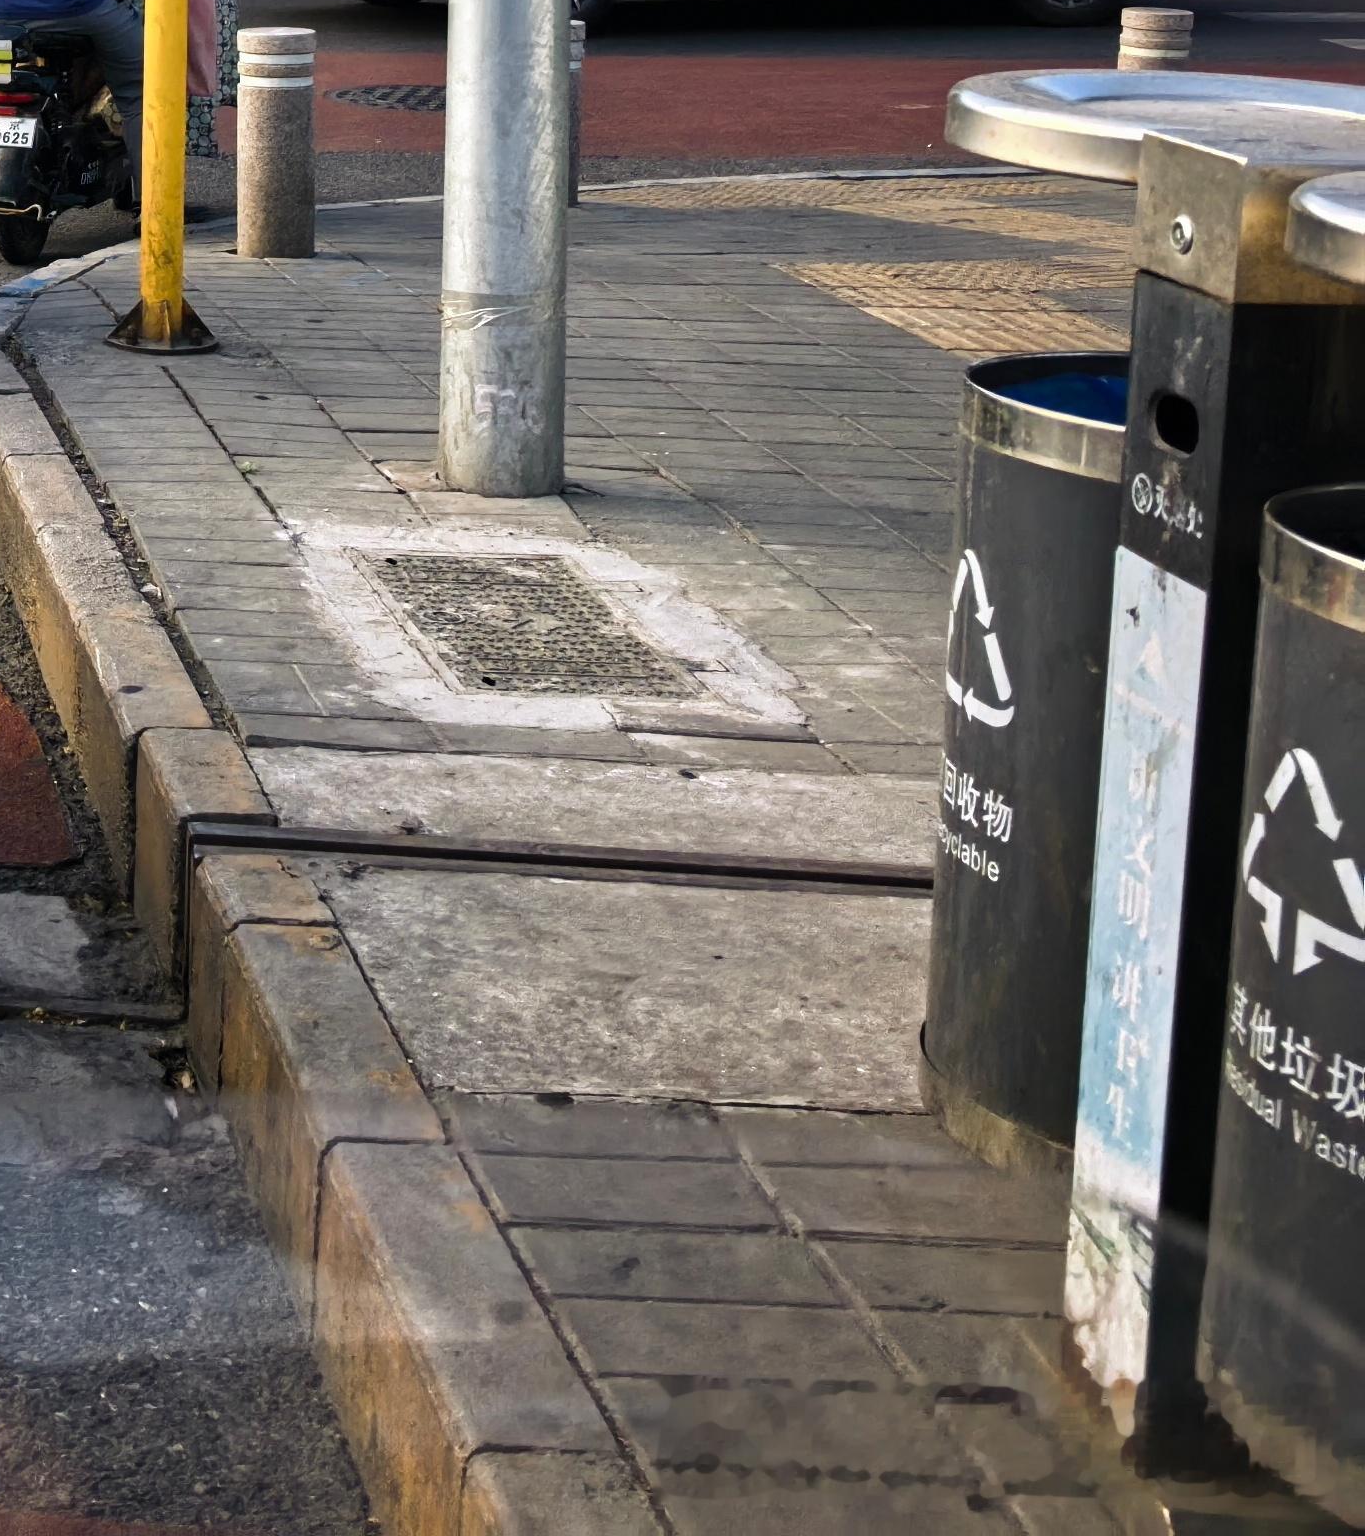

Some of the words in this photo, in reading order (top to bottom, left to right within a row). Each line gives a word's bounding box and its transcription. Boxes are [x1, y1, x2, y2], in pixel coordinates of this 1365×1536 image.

[943, 754, 1012, 842] 回收物
[1230, 982, 1365, 1117] 其他垃圾
